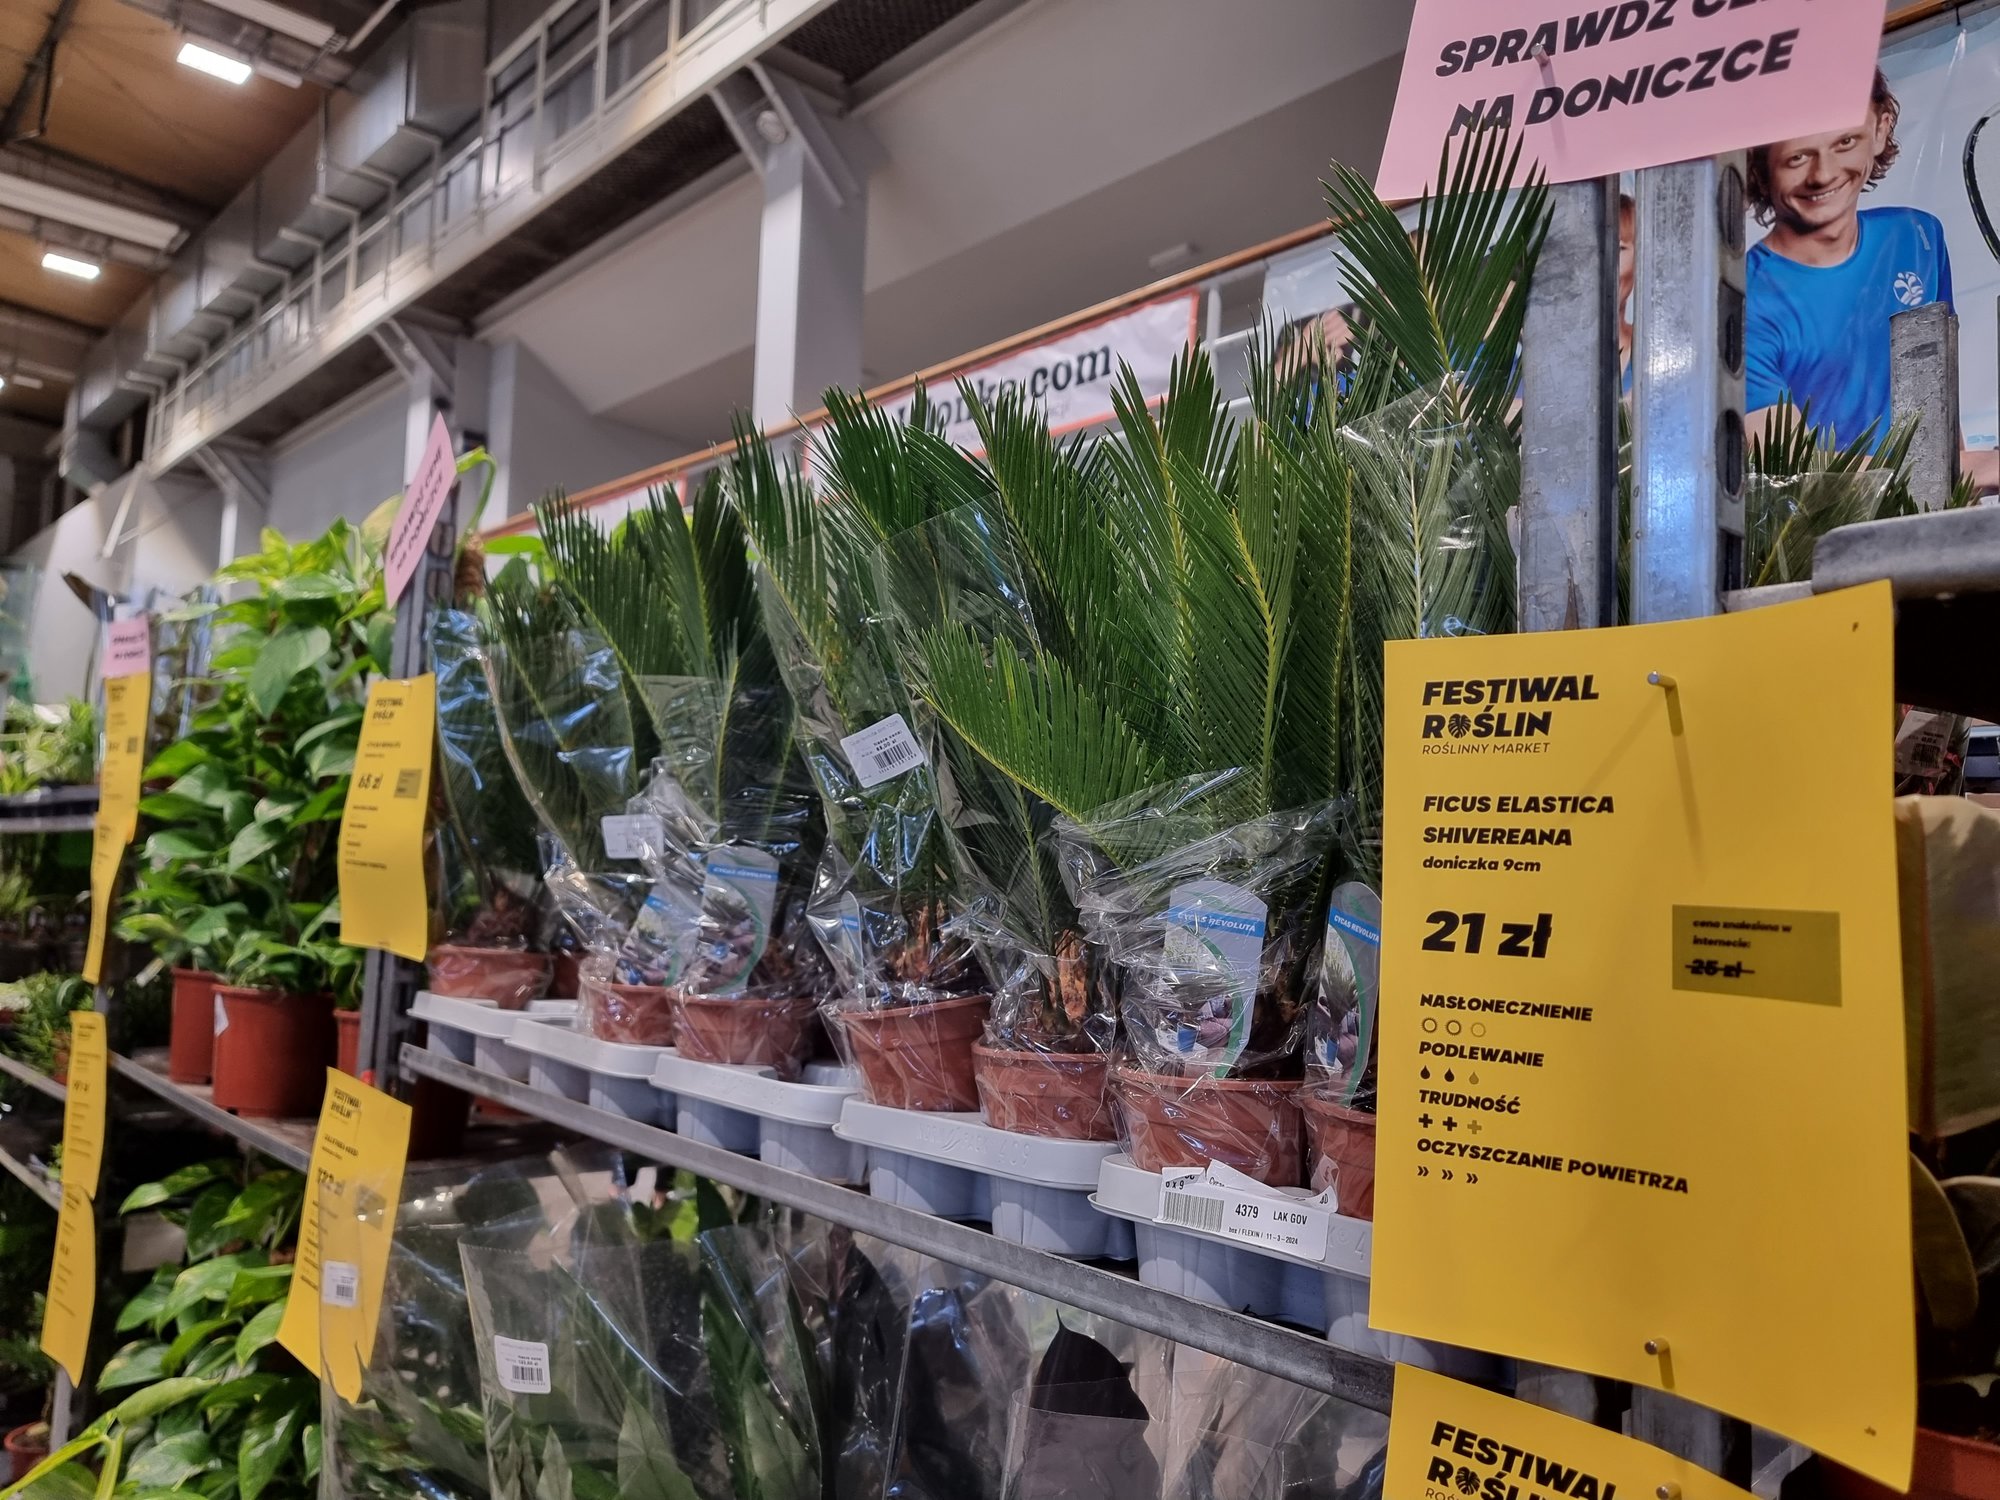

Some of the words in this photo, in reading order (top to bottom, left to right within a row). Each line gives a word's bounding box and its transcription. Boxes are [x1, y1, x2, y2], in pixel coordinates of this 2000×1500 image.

[1447, 93, 1515, 136] NA
[1525, 28, 1800, 126] DONICZCE
[1423, 675, 1599, 705] FESTIWAL
[1422, 741, 1489, 755] ROŚLINNY
[1493, 742, 1550, 754] MARKET
[1424, 796, 1491, 813] FICUS
[1497, 796, 1614, 814] ELASTICA
[1423, 827, 1572, 846] SHIVEREANA
[1423, 856, 1499, 871] doniczka
[1503, 858, 1541, 872] 9cm
[1208, 917, 1256, 933] REVOLUTA
[1334, 914, 1351, 928] CYCAS
[1781, 925, 1792, 933] w
[1421, 911, 1486, 954] 21
[1498, 913, 1552, 959] zł
[1420, 994, 1593, 1022] NASŁONECZNIENIE
[1419, 1042, 1544, 1068] PODLEWANIE
[1419, 1090, 1521, 1115] TRUDNOŚĆ
[1417, 1138, 1563, 1172] OCZYSZCZANIE
[1568, 1159, 1688, 1194] POWIETRZA
[1179, 1180, 1185, 1190] 9
[1235, 1203, 1259, 1219] 4379
[1273, 1210, 1289, 1223] LAK
[1290, 1213, 1308, 1225] GOV
[1241, 1228, 1260, 1238] FLEXIN
